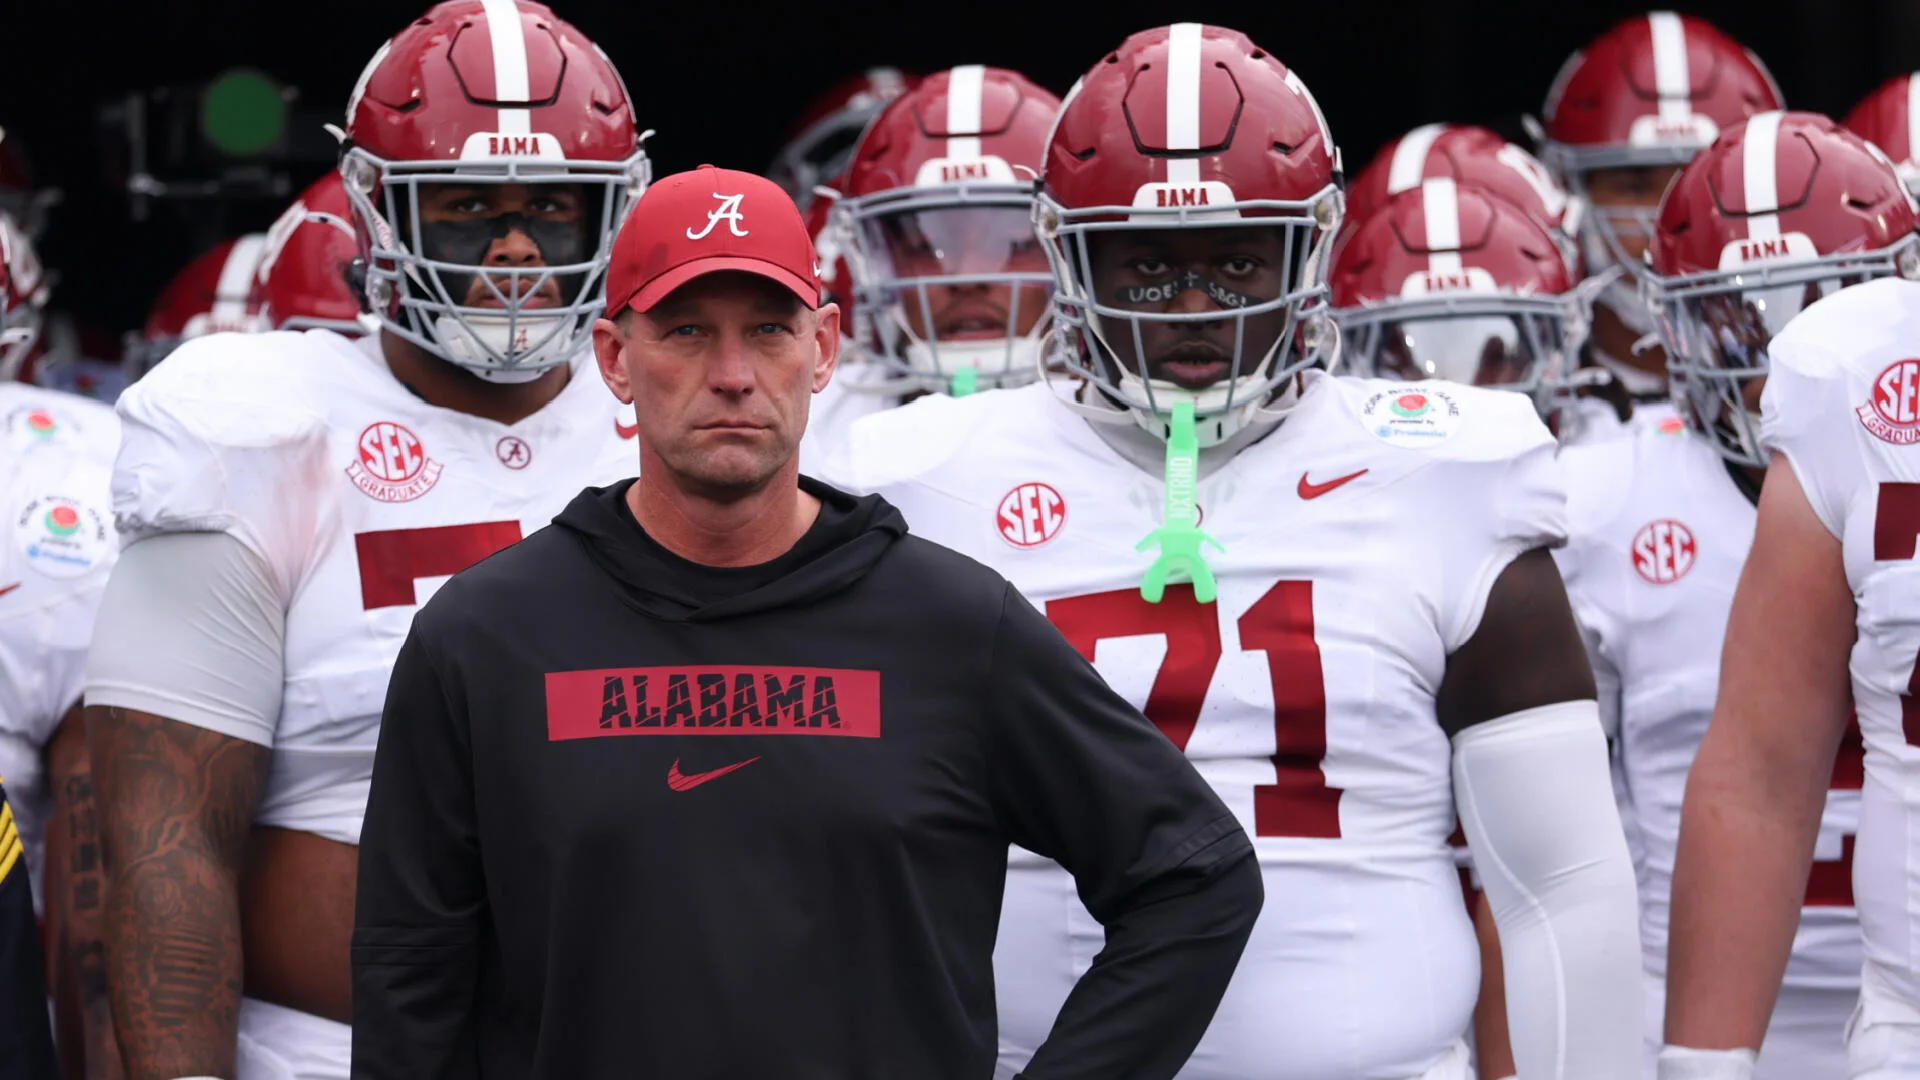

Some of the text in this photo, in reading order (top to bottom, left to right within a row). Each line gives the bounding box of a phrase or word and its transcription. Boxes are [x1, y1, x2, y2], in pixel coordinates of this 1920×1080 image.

[489, 136, 541, 156] BAMA
[686, 191, 750, 241] A
[1156, 187, 1209, 208] BAMA
[1740, 239, 1791, 262] BAMA
[1875, 361, 1920, 424] SE
[361, 423, 423, 480] SEC
[358, 472, 433, 501] GRADUATE
[998, 484, 1064, 544] SEC
[1168, 456, 1194, 519] NXTRND
[1632, 522, 1695, 582] SEC
[599, 673, 841, 729] ALABAMA
[1045, 580, 1345, 839] 71
